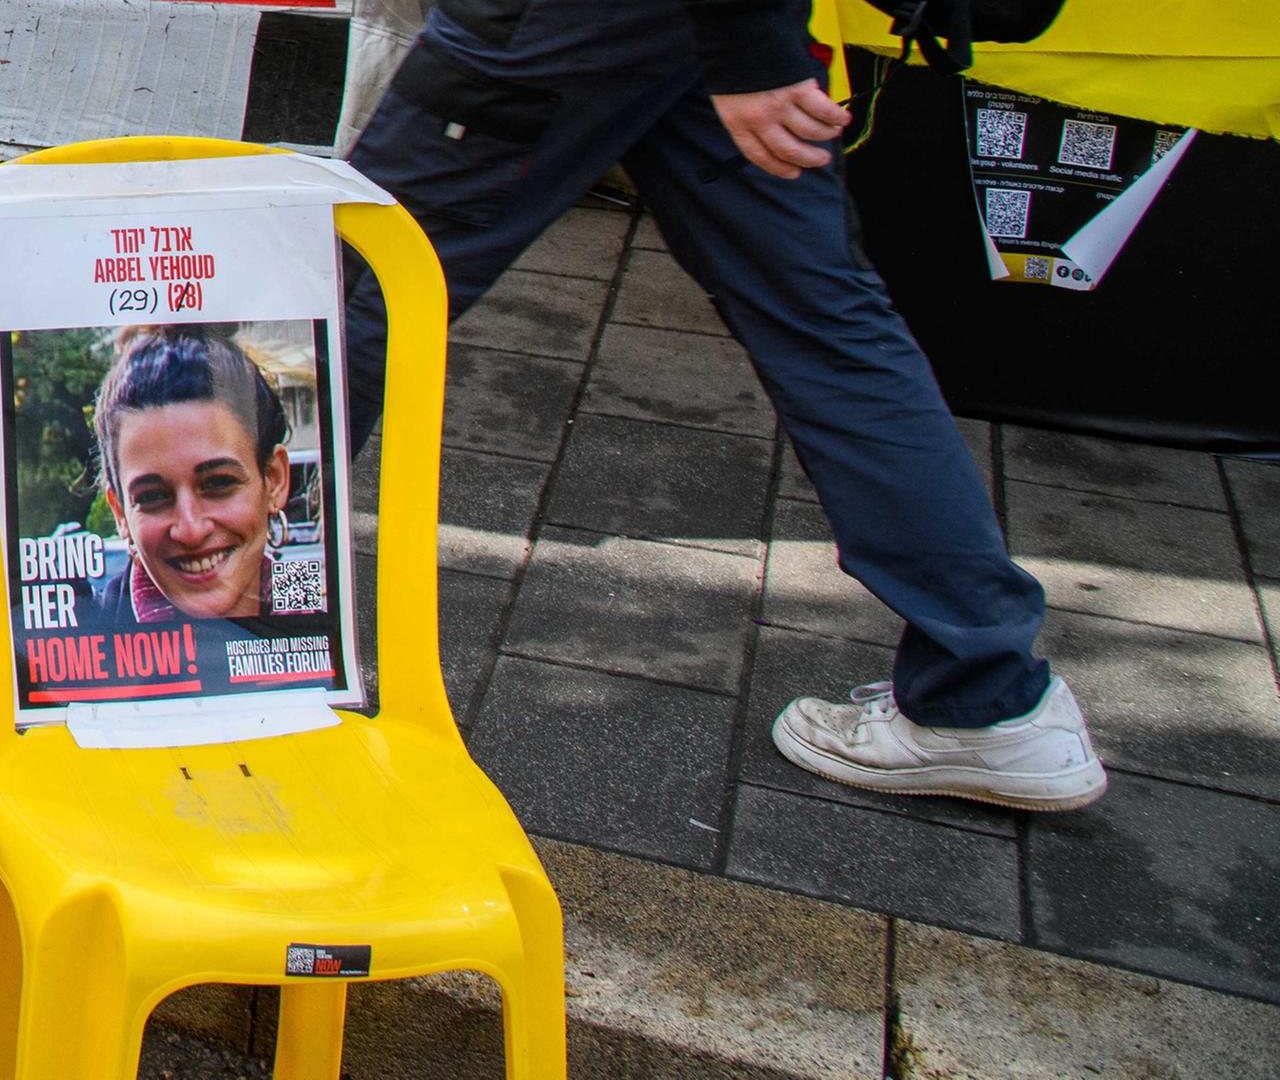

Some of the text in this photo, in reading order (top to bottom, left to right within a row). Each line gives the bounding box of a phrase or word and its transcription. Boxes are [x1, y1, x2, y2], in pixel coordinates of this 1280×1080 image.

[1049, 164, 1074, 176] Social
[1075, 169, 1098, 179] media
[111, 225, 193, 255] ארבל יהוד
[95, 255, 215, 283] ARBEL YEHOUD
[109, 282, 203, 317] (29) (28)
[19, 533, 105, 582] BRING
[23, 584, 78, 629] HER
[27, 625, 199, 683] HOME NOW!
[226, 635, 330, 656] HOSTAGES AND MISSING
